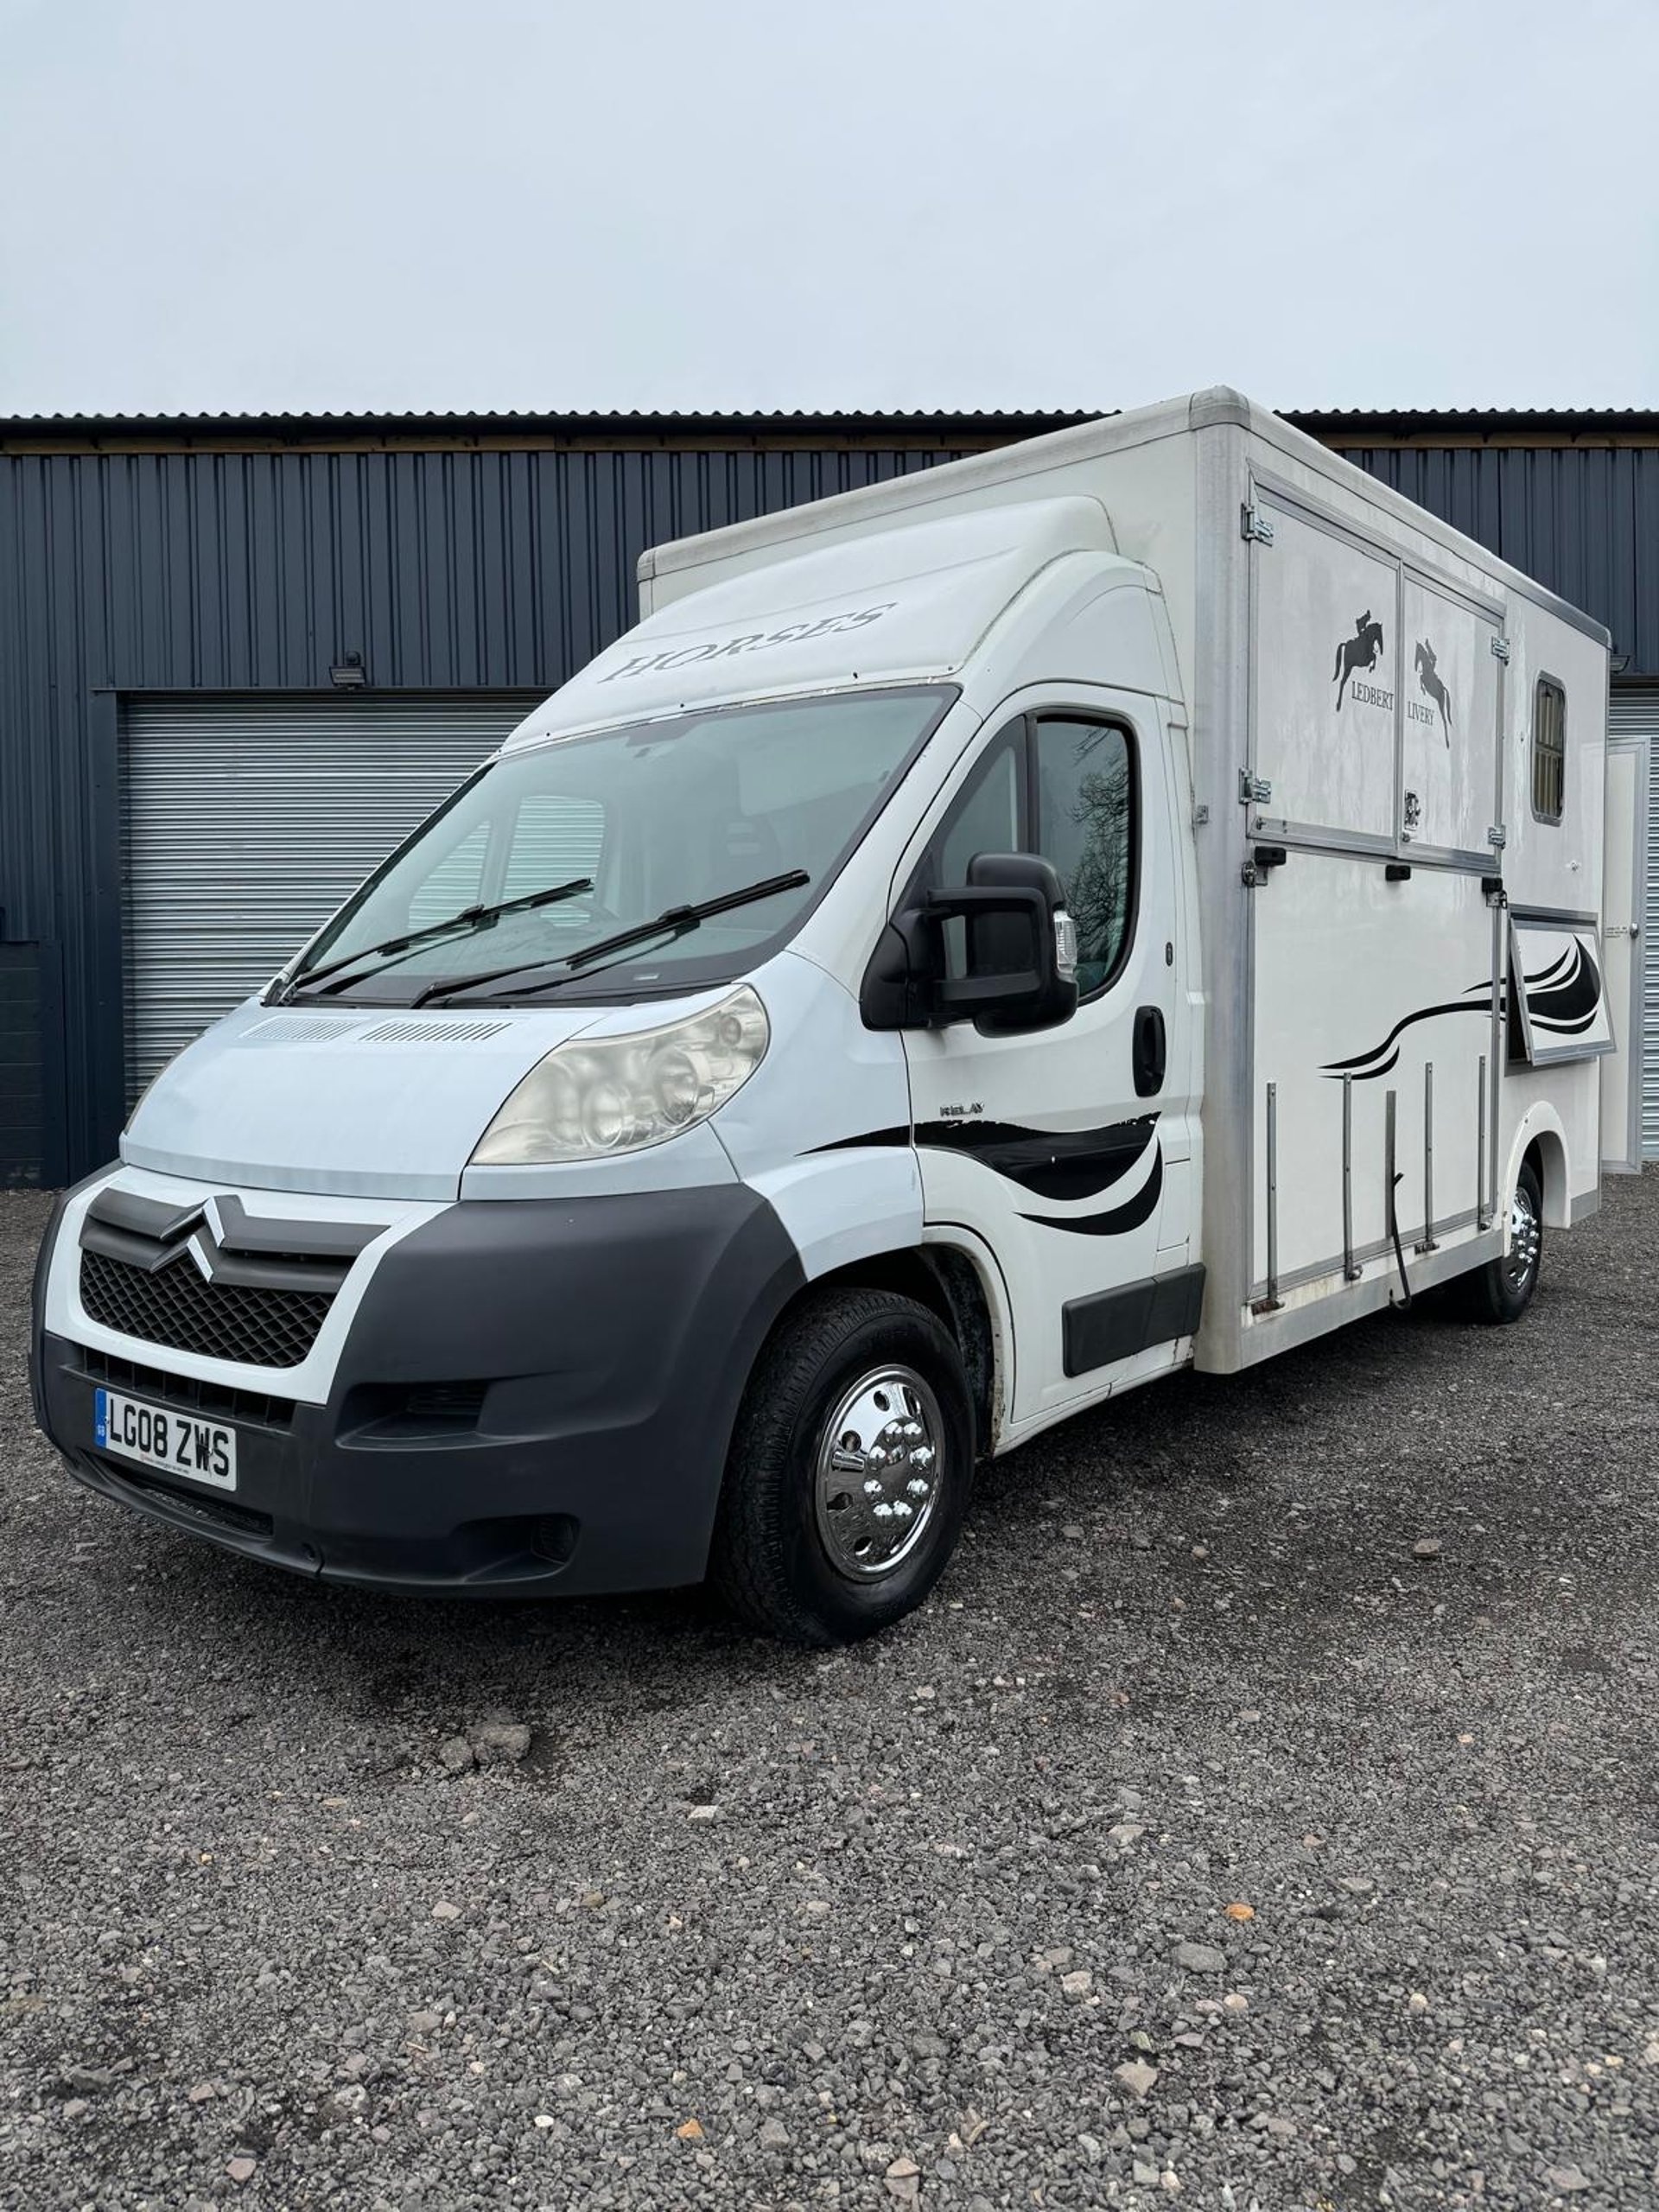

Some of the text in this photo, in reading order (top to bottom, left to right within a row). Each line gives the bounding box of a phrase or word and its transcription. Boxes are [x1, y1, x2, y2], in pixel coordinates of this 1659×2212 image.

[598, 602, 898, 684] HORSES
[1351, 681, 1394, 710] LEDBERT
[1407, 701, 1434, 726] LIVERY
[939, 1102, 985, 1117] RELAY
[110, 1398, 229, 1477] LG08 ZWS
